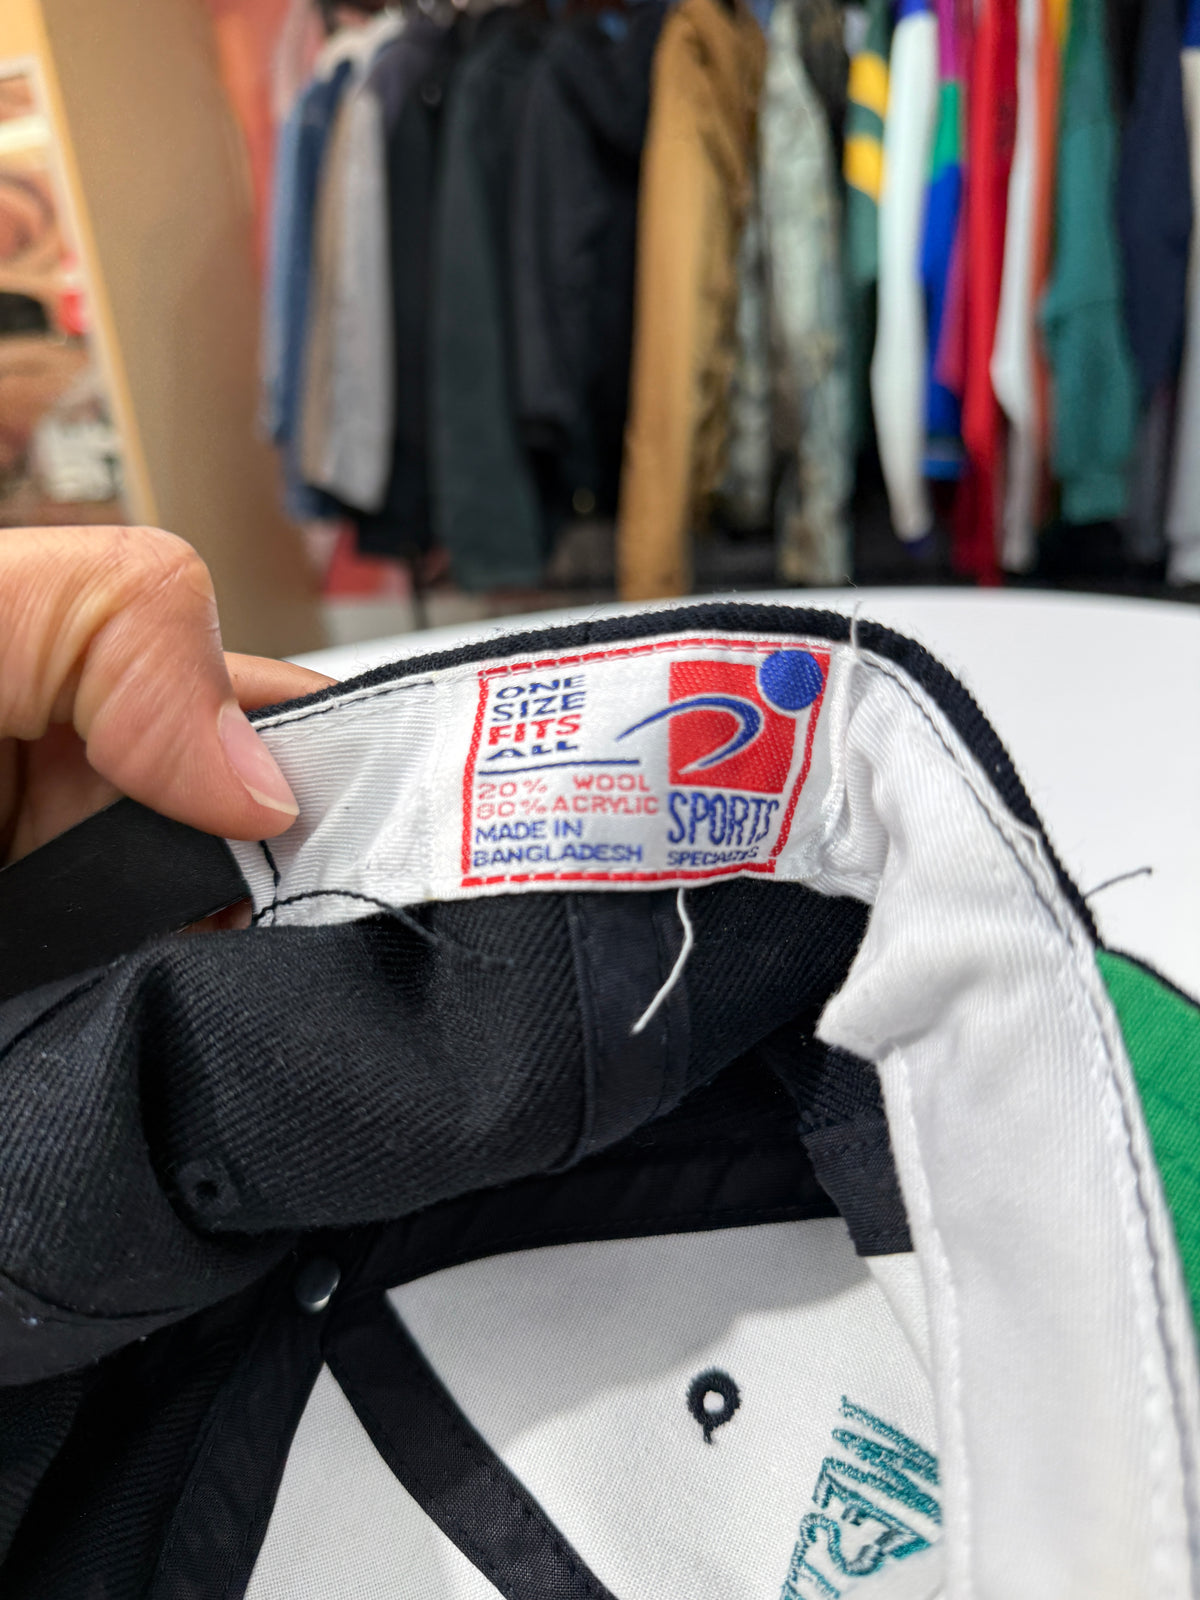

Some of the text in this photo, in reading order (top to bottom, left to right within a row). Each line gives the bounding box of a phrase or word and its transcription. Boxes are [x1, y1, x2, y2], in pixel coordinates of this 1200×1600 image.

[496, 675, 585, 699] ONE
[492, 692, 586, 722] SIZE
[487, 714, 581, 746] FITS
[486, 740, 579, 761] ALL
[572, 773, 651, 792] WOOL
[552, 795, 660, 815] ACRYLIC
[667, 791, 780, 846] SPORTS
[475, 818, 583, 844] MADE IN
[473, 843, 643, 867] BANGLADESH
